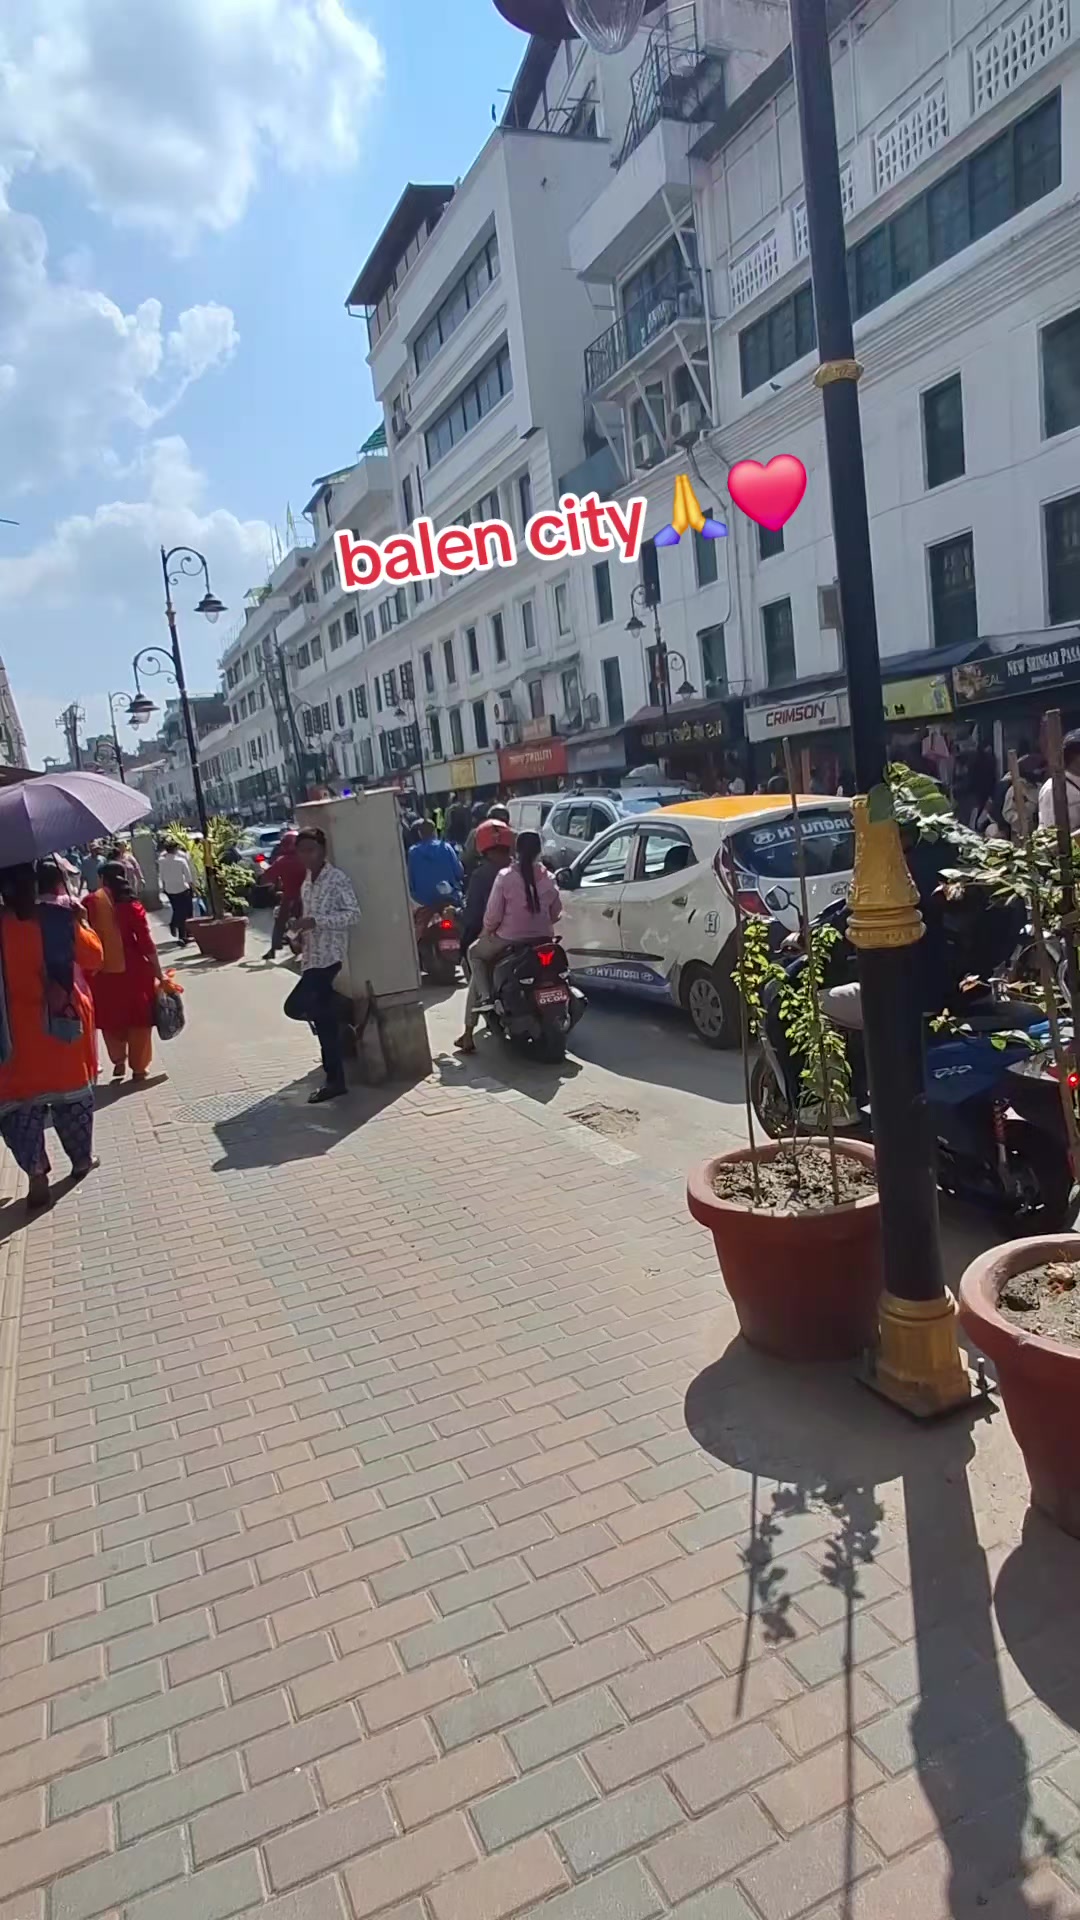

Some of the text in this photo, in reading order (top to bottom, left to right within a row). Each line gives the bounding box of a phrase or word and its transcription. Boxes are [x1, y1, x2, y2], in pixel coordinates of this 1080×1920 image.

[1007, 659, 1025, 677] NEW
[766, 701, 825, 727] CRIMSON
[596, 967, 640, 980] HYUNDAI
